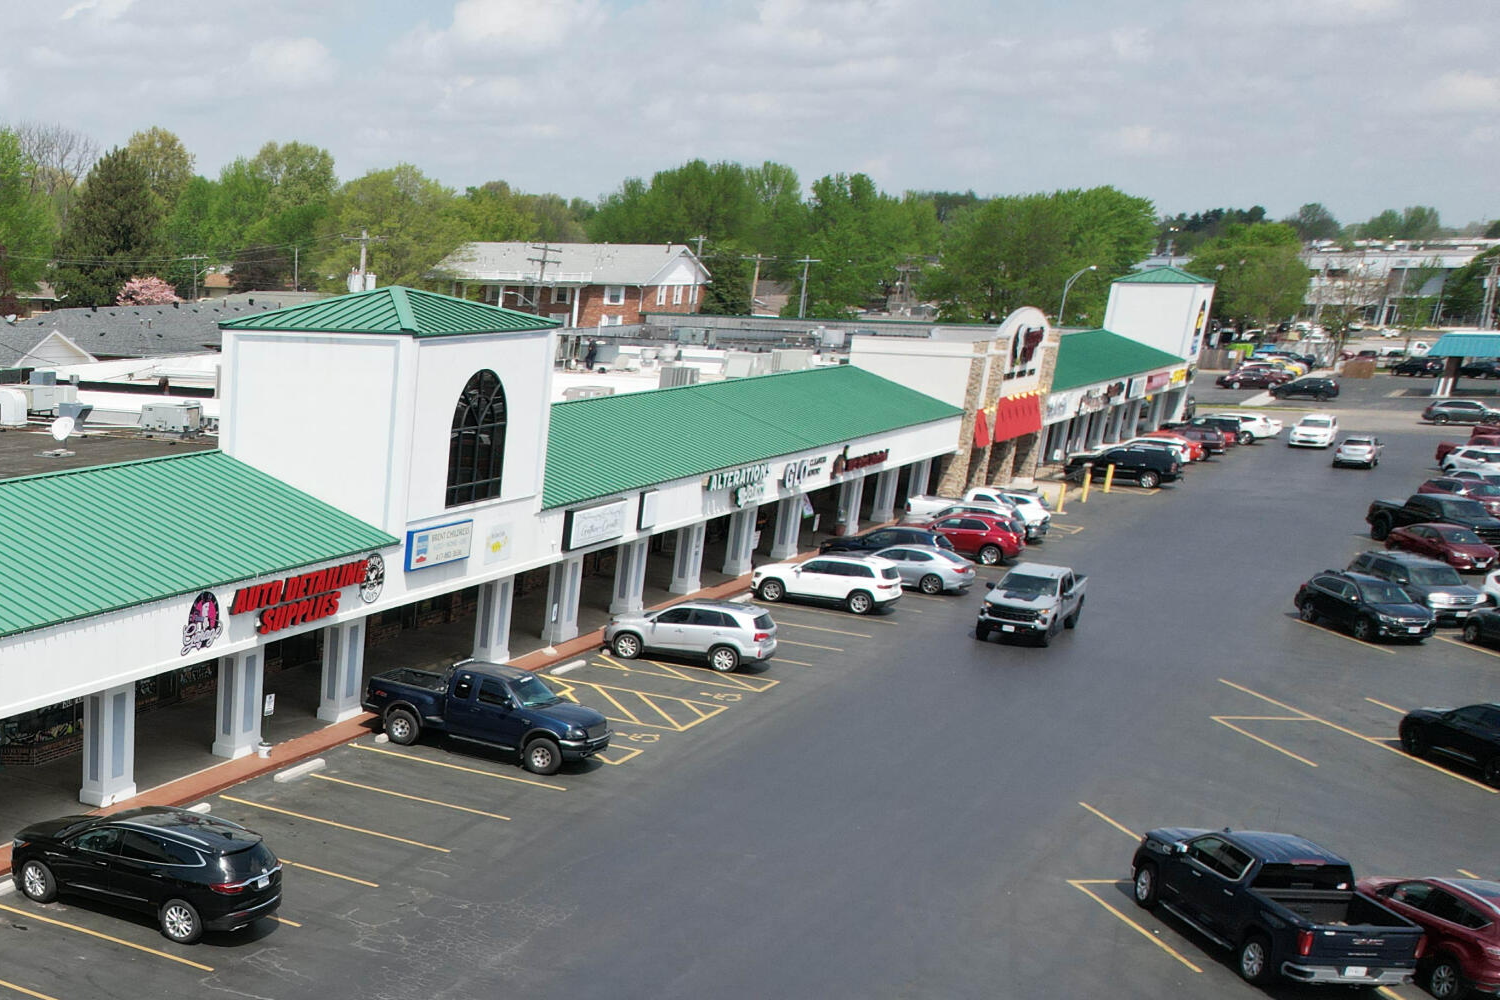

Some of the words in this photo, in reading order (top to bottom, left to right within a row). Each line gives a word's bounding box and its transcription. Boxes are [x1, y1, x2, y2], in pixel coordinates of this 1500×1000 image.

[709, 463, 772, 491] ALTERATIONS
[230, 580, 284, 616] AUTO
[282, 559, 368, 602] DETAILING
[258, 591, 341, 635] SUPPLIES
